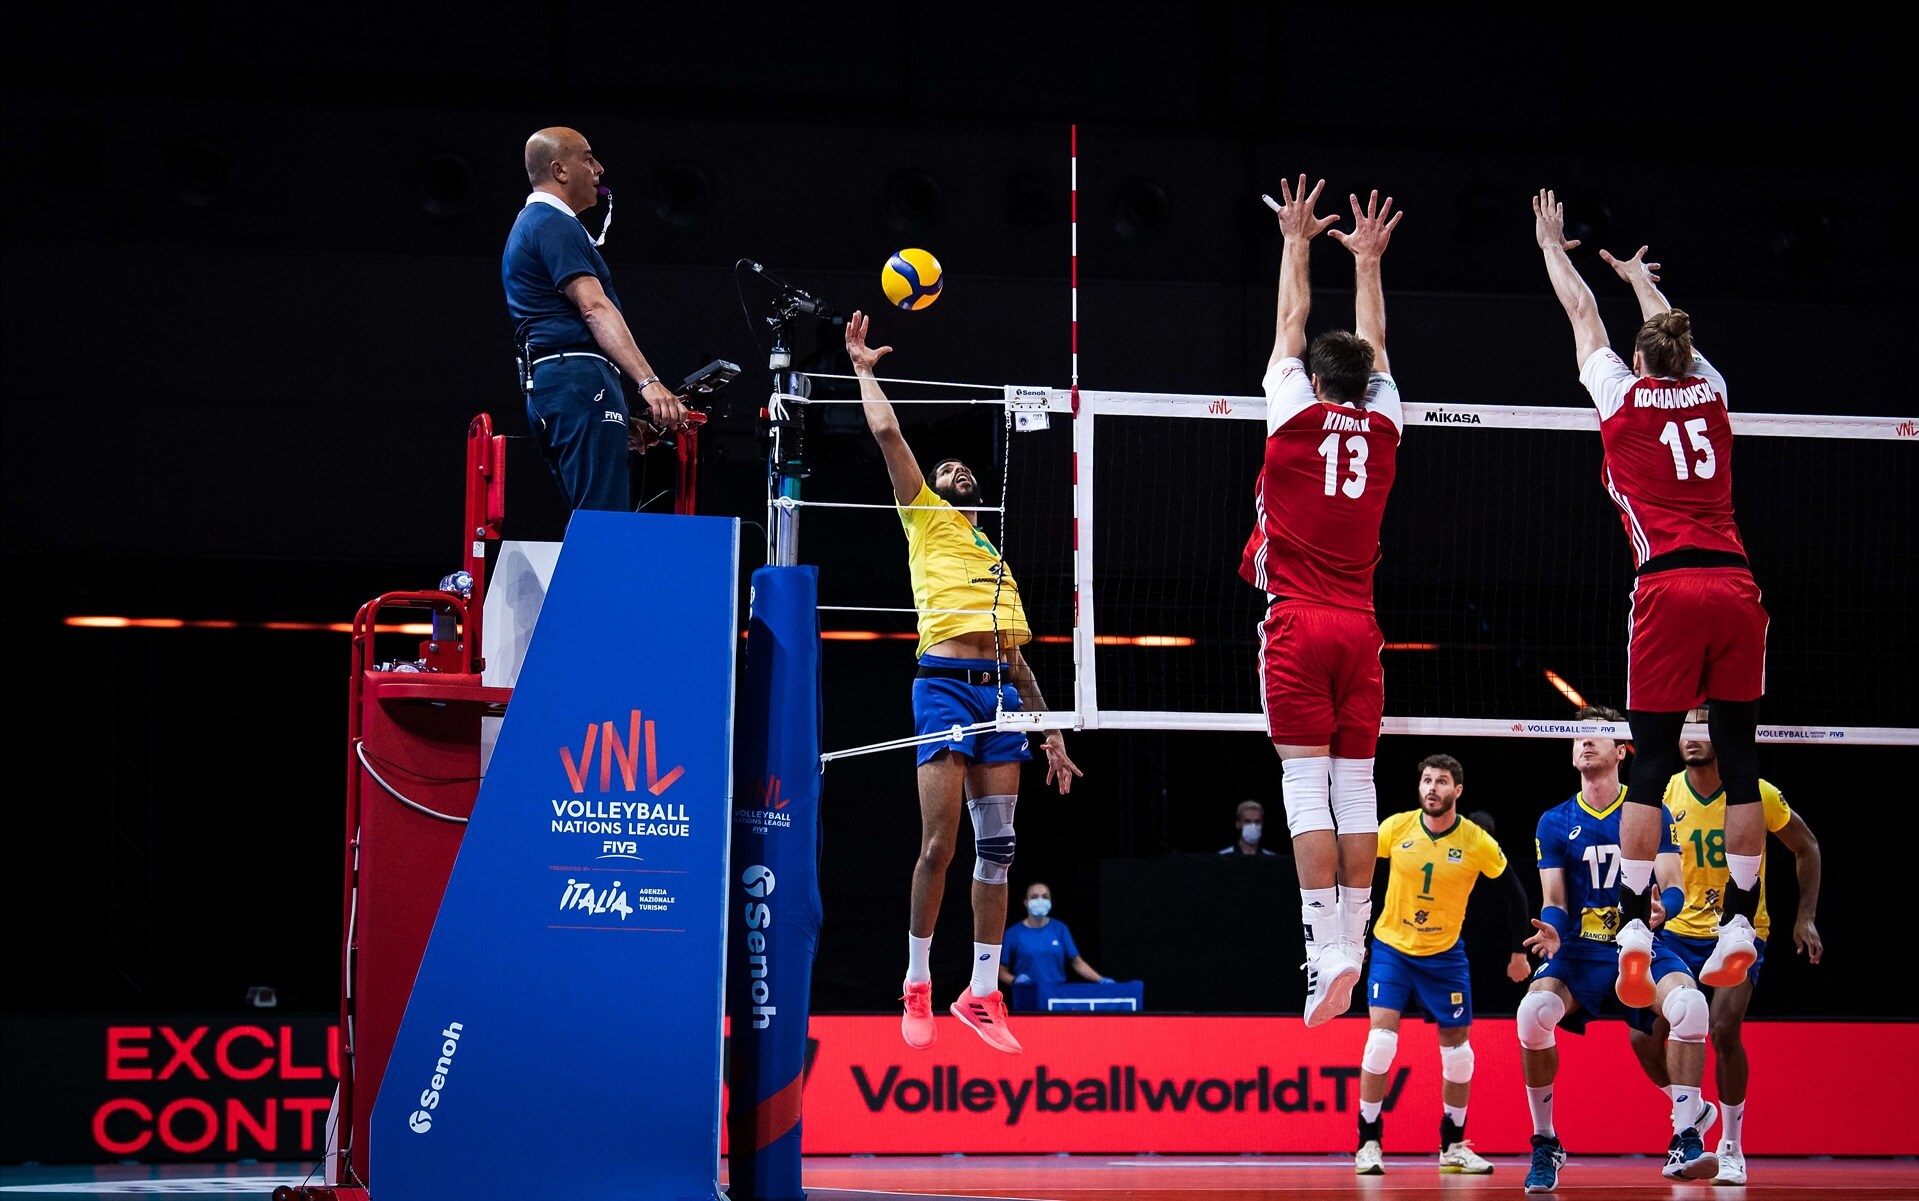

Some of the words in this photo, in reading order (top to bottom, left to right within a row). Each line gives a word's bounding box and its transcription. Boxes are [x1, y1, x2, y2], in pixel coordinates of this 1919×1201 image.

[1208, 398, 1232, 415] VNL
[605, 411, 624, 421] FIVB
[1659, 417, 1716, 480] 15
[1318, 433, 1369, 499] 13
[1528, 725, 1580, 733] VOLLEYBALL
[1757, 730, 1809, 738] VOLLEYBALL
[559, 709, 686, 796] VNL
[551, 799, 690, 821] VOLLEYBALL
[734, 809, 791, 821] VOLLEYBALL
[551, 820, 622, 834] NATIONS
[628, 822, 690, 837] LEAGUE
[764, 819, 791, 828] LEAGUE
[603, 840, 637, 854] FIVB
[1689, 829, 1726, 868] 18
[1581, 844, 1621, 889] 17
[1421, 862, 1434, 894] 1
[639, 896, 676, 904] NAZIONALE
[745, 902, 776, 1029] Senoh
[1372, 983, 1379, 999] 1
[420, 1021, 464, 1110] Senoh
